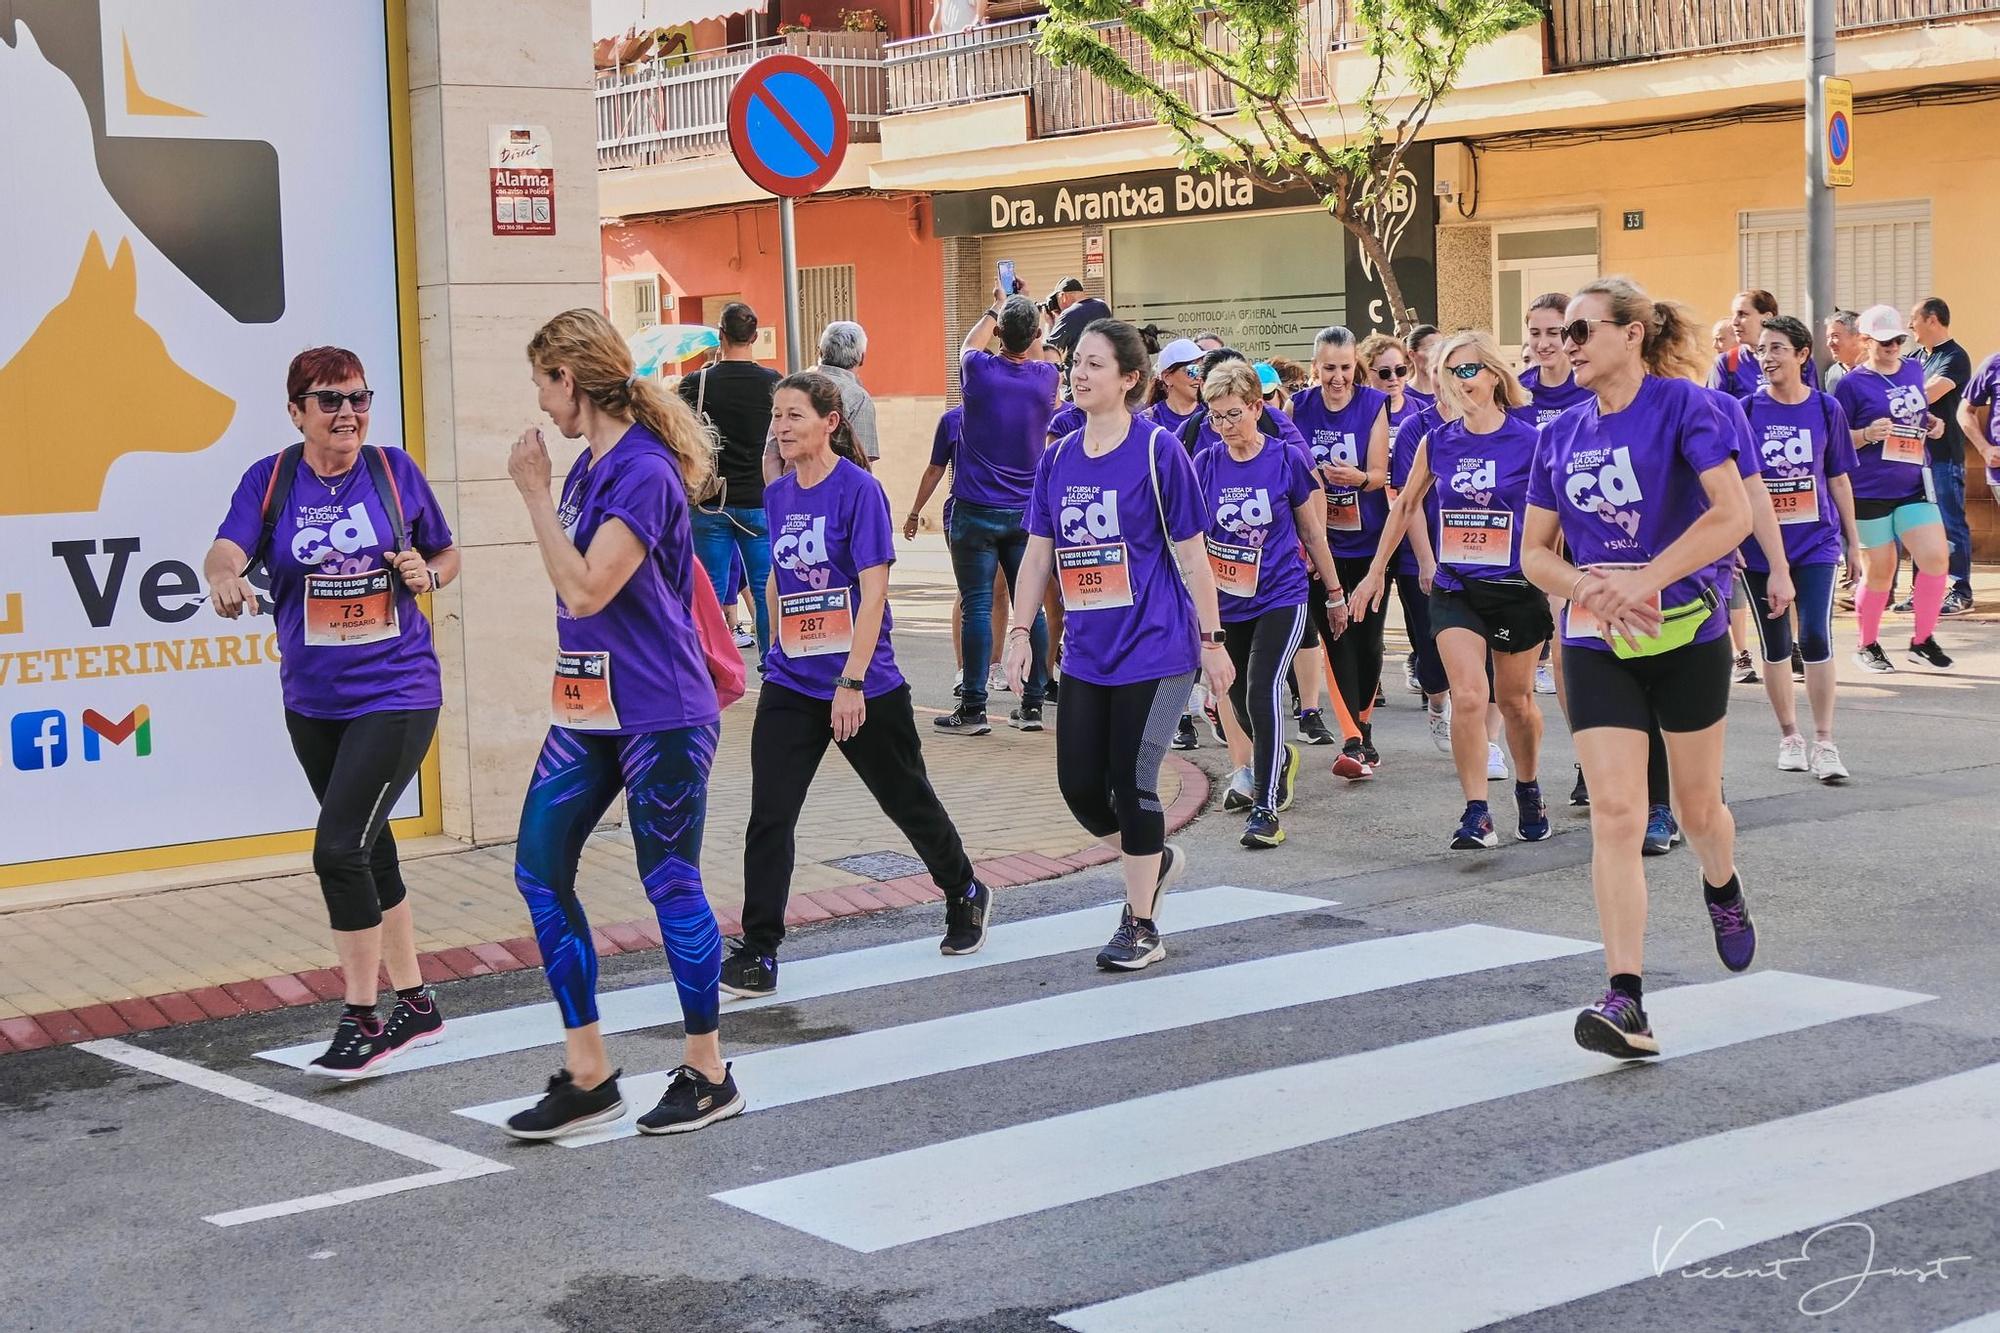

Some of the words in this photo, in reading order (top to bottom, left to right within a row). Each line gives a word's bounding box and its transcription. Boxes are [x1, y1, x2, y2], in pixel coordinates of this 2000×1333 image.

[496, 171, 549, 186] Alarma
[991, 194, 1044, 228] Dra.
[1054, 183, 1164, 222] Arantxa
[1175, 171, 1254, 211] Bolta
[1628, 215, 1639, 227] 33
[1178, 311, 1236, 323] ODONTOLOGIA
[1242, 322, 1298, 335] ORTODÒNCIA
[1580, 449, 1601, 458] CURSA
[1774, 498, 1796, 507] 213
[1462, 532, 1487, 543] 223
[1218, 563, 1236, 576] 310
[1078, 572, 1102, 586] 285
[340, 604, 364, 619] 73
[342, 618, 375, 628] ROSARIO
[800, 617, 824, 632] 287
[565, 684, 581, 700] 44
